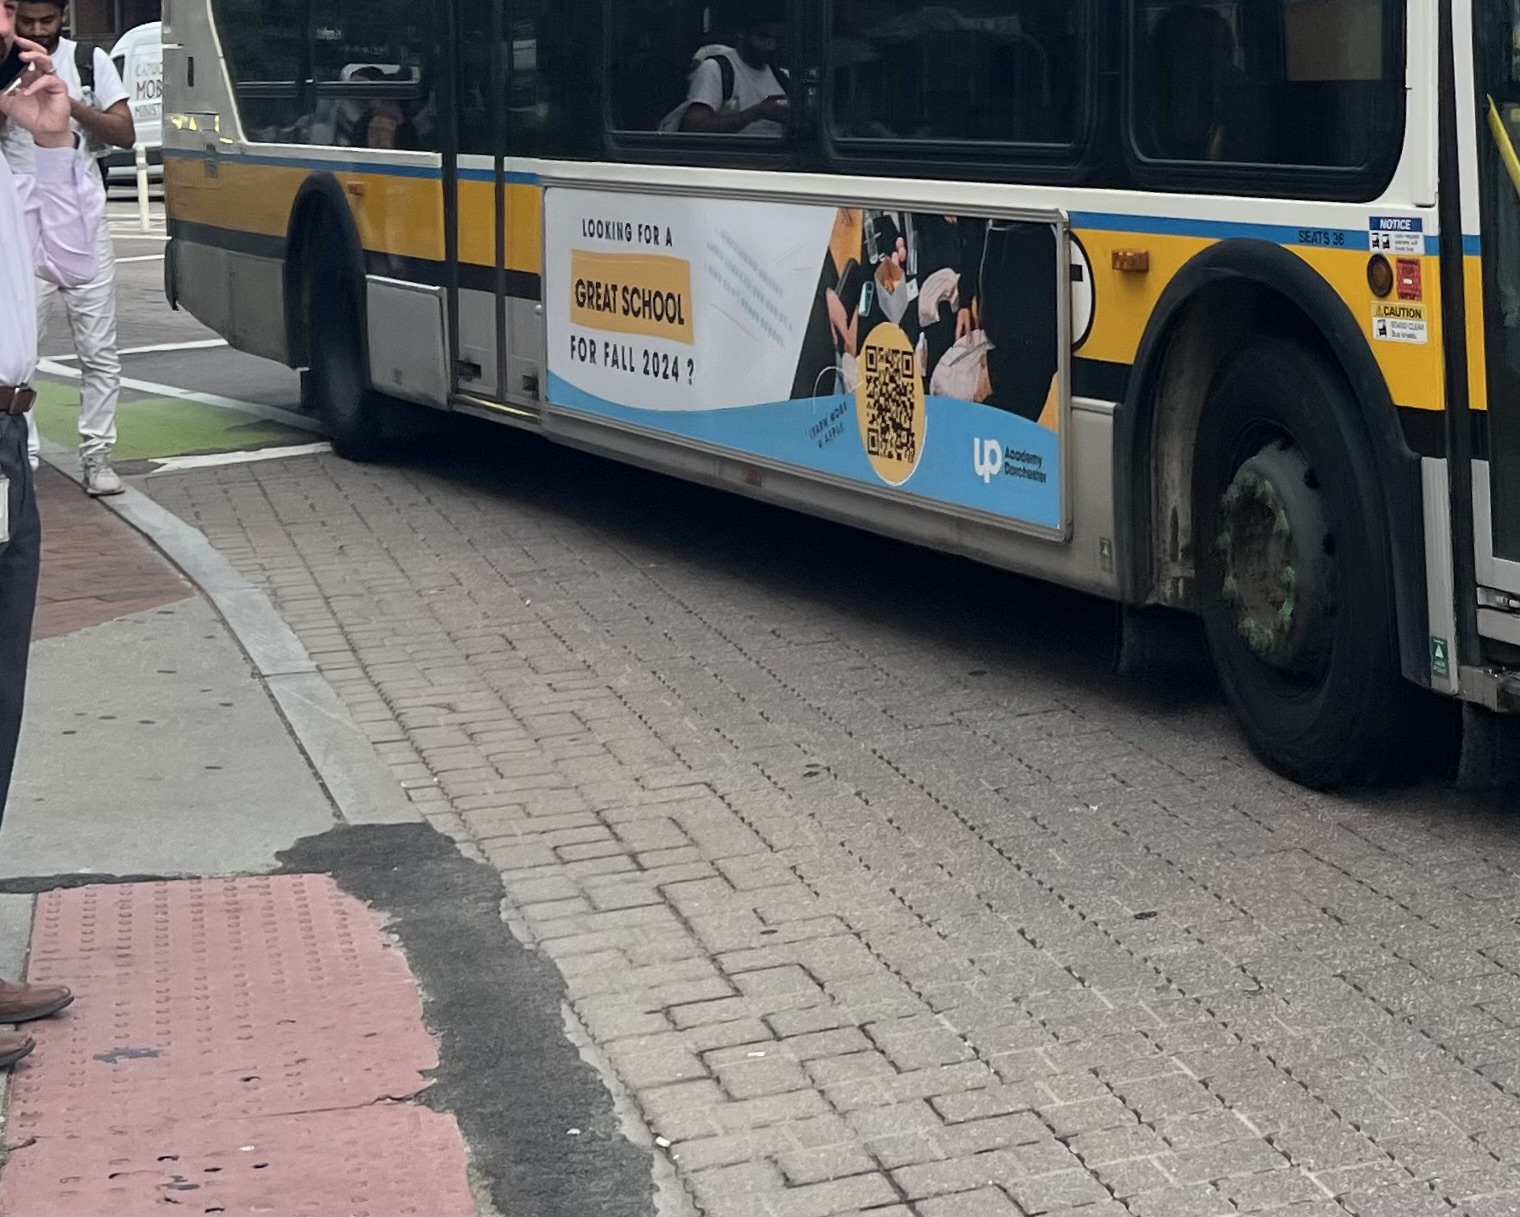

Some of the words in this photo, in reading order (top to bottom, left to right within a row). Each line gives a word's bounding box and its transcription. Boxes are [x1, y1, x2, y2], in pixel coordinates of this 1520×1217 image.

[136, 79, 163, 100] MOB
[582, 218, 632, 243] LOOKING
[637, 224, 660, 246] FOR
[665, 227, 673, 247] A
[1380, 218, 1412, 231] NOTICE
[1299, 230, 1330, 245] SEATS
[575, 279, 618, 313] GREAT
[621, 285, 685, 325] SCHOOL
[1383, 306, 1422, 319] CAUTION
[570, 335, 597, 365] FOR
[604, 342, 635, 373] FALL
[642, 349, 679, 383] 2024
[1005, 446, 1043, 470] Academy
